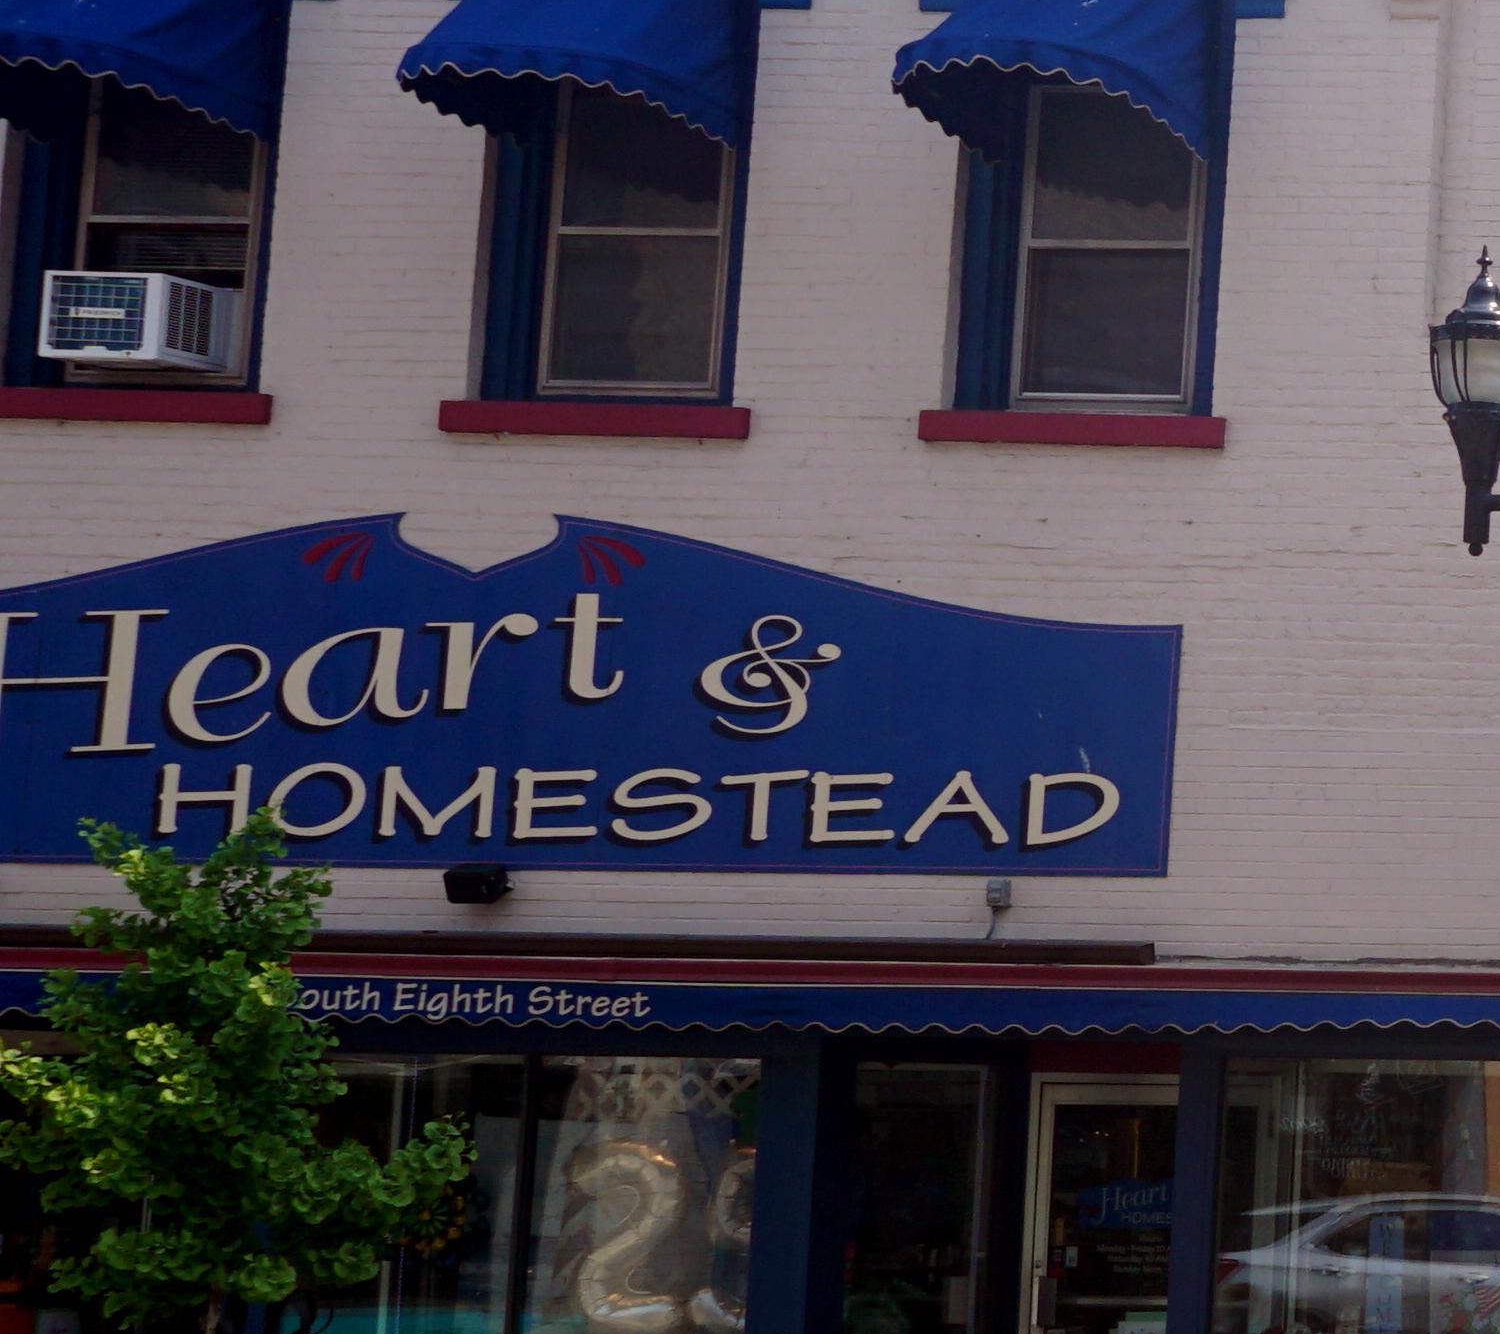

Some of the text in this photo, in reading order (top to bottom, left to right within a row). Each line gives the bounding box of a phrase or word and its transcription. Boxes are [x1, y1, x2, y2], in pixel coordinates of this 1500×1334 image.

[0, 593, 842, 754] Heart &
[157, 761, 1121, 846] HOMESTEAD
[286, 981, 652, 1020] outh Eighth Street
